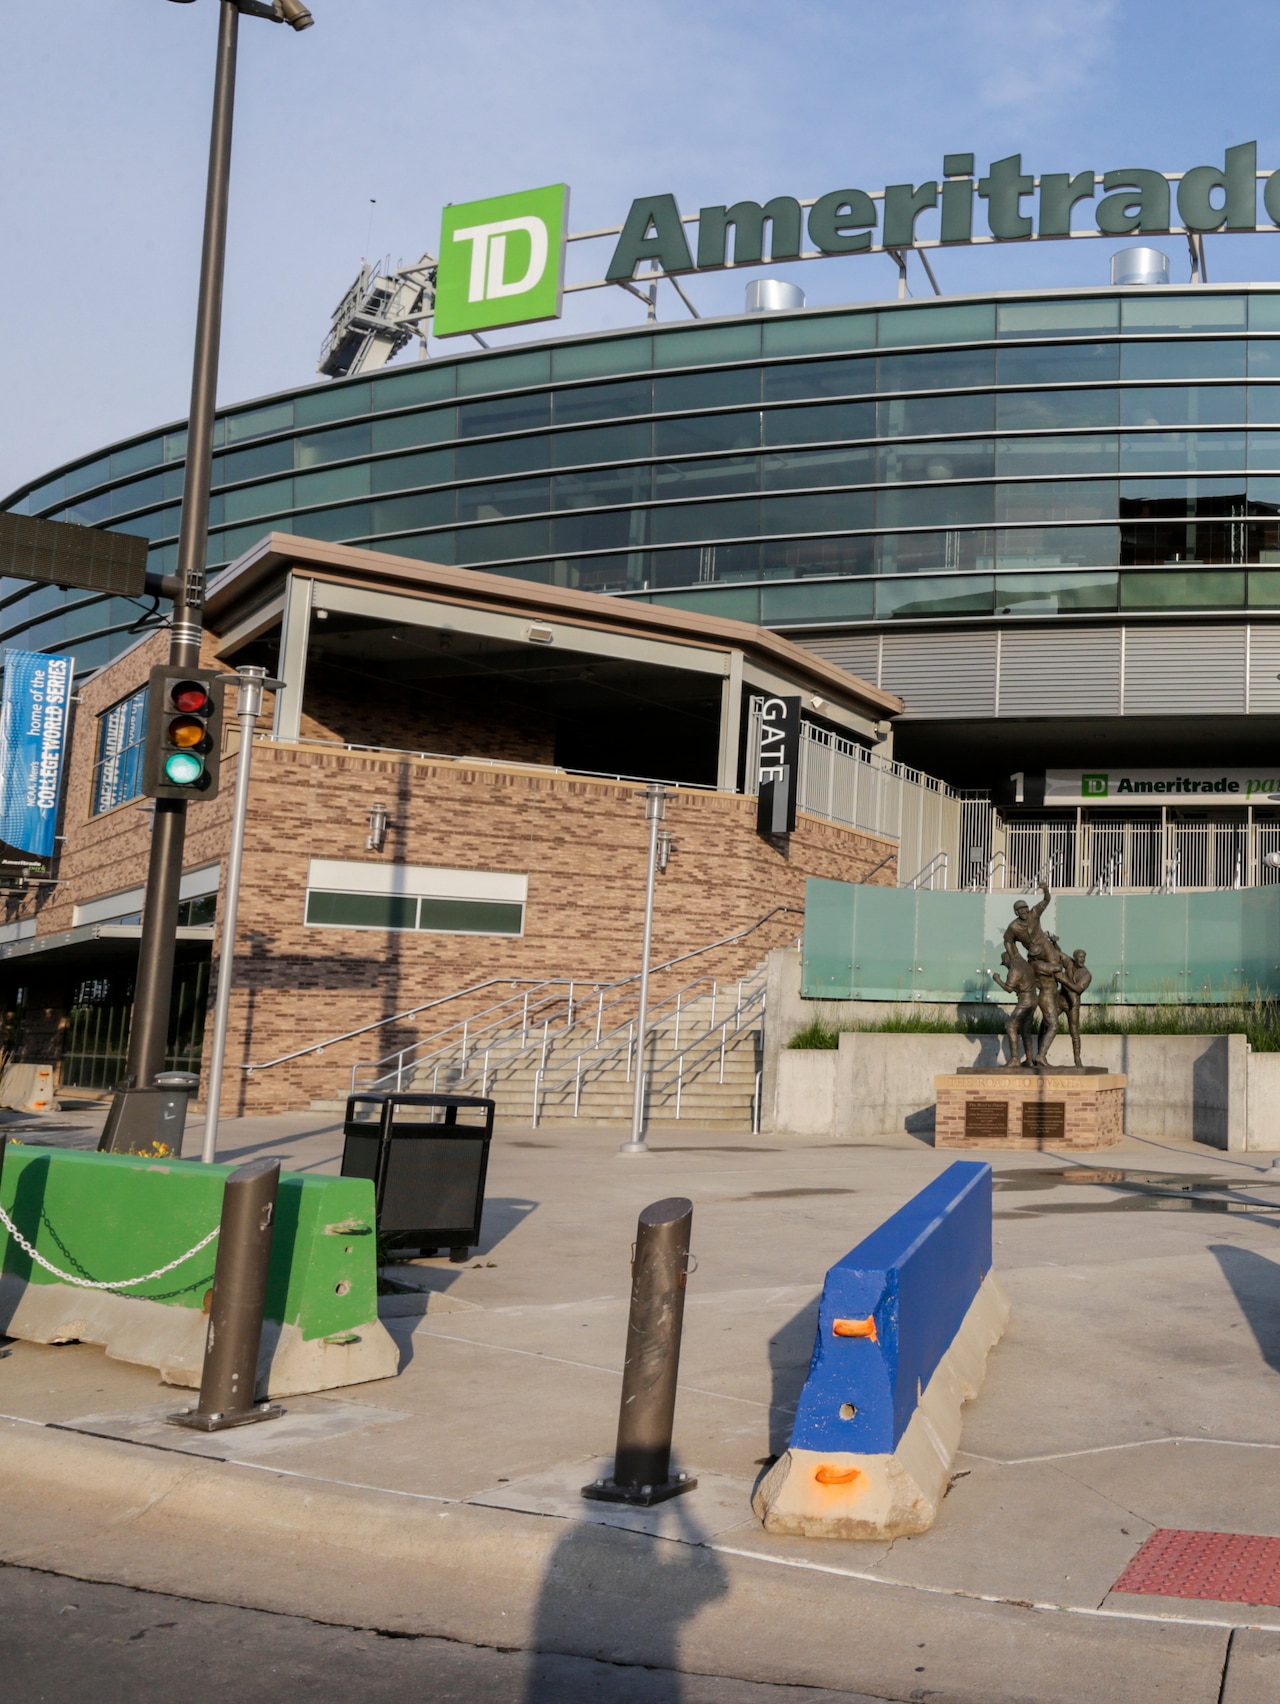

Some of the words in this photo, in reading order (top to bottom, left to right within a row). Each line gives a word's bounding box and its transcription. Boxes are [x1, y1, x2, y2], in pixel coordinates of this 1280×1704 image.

[452, 215, 550, 304] TD
[33, 670, 46, 688] the
[31, 688, 44, 705] of
[27, 706, 42, 736] home
[42, 705, 63, 751] WORLD
[759, 698, 787, 782] GATE
[37, 747, 60, 809] COLLEGE
[1009, 772, 1024, 803] 1
[1086, 778, 1106, 794] TD
[1117, 777, 1240, 794] Ameritrade
[949, 1078, 973, 1087] THE
[978, 1078, 1010, 1087] ROAD
[1015, 1078, 1031, 1087] TO
[1037, 1078, 1084, 1087] OMAHA
